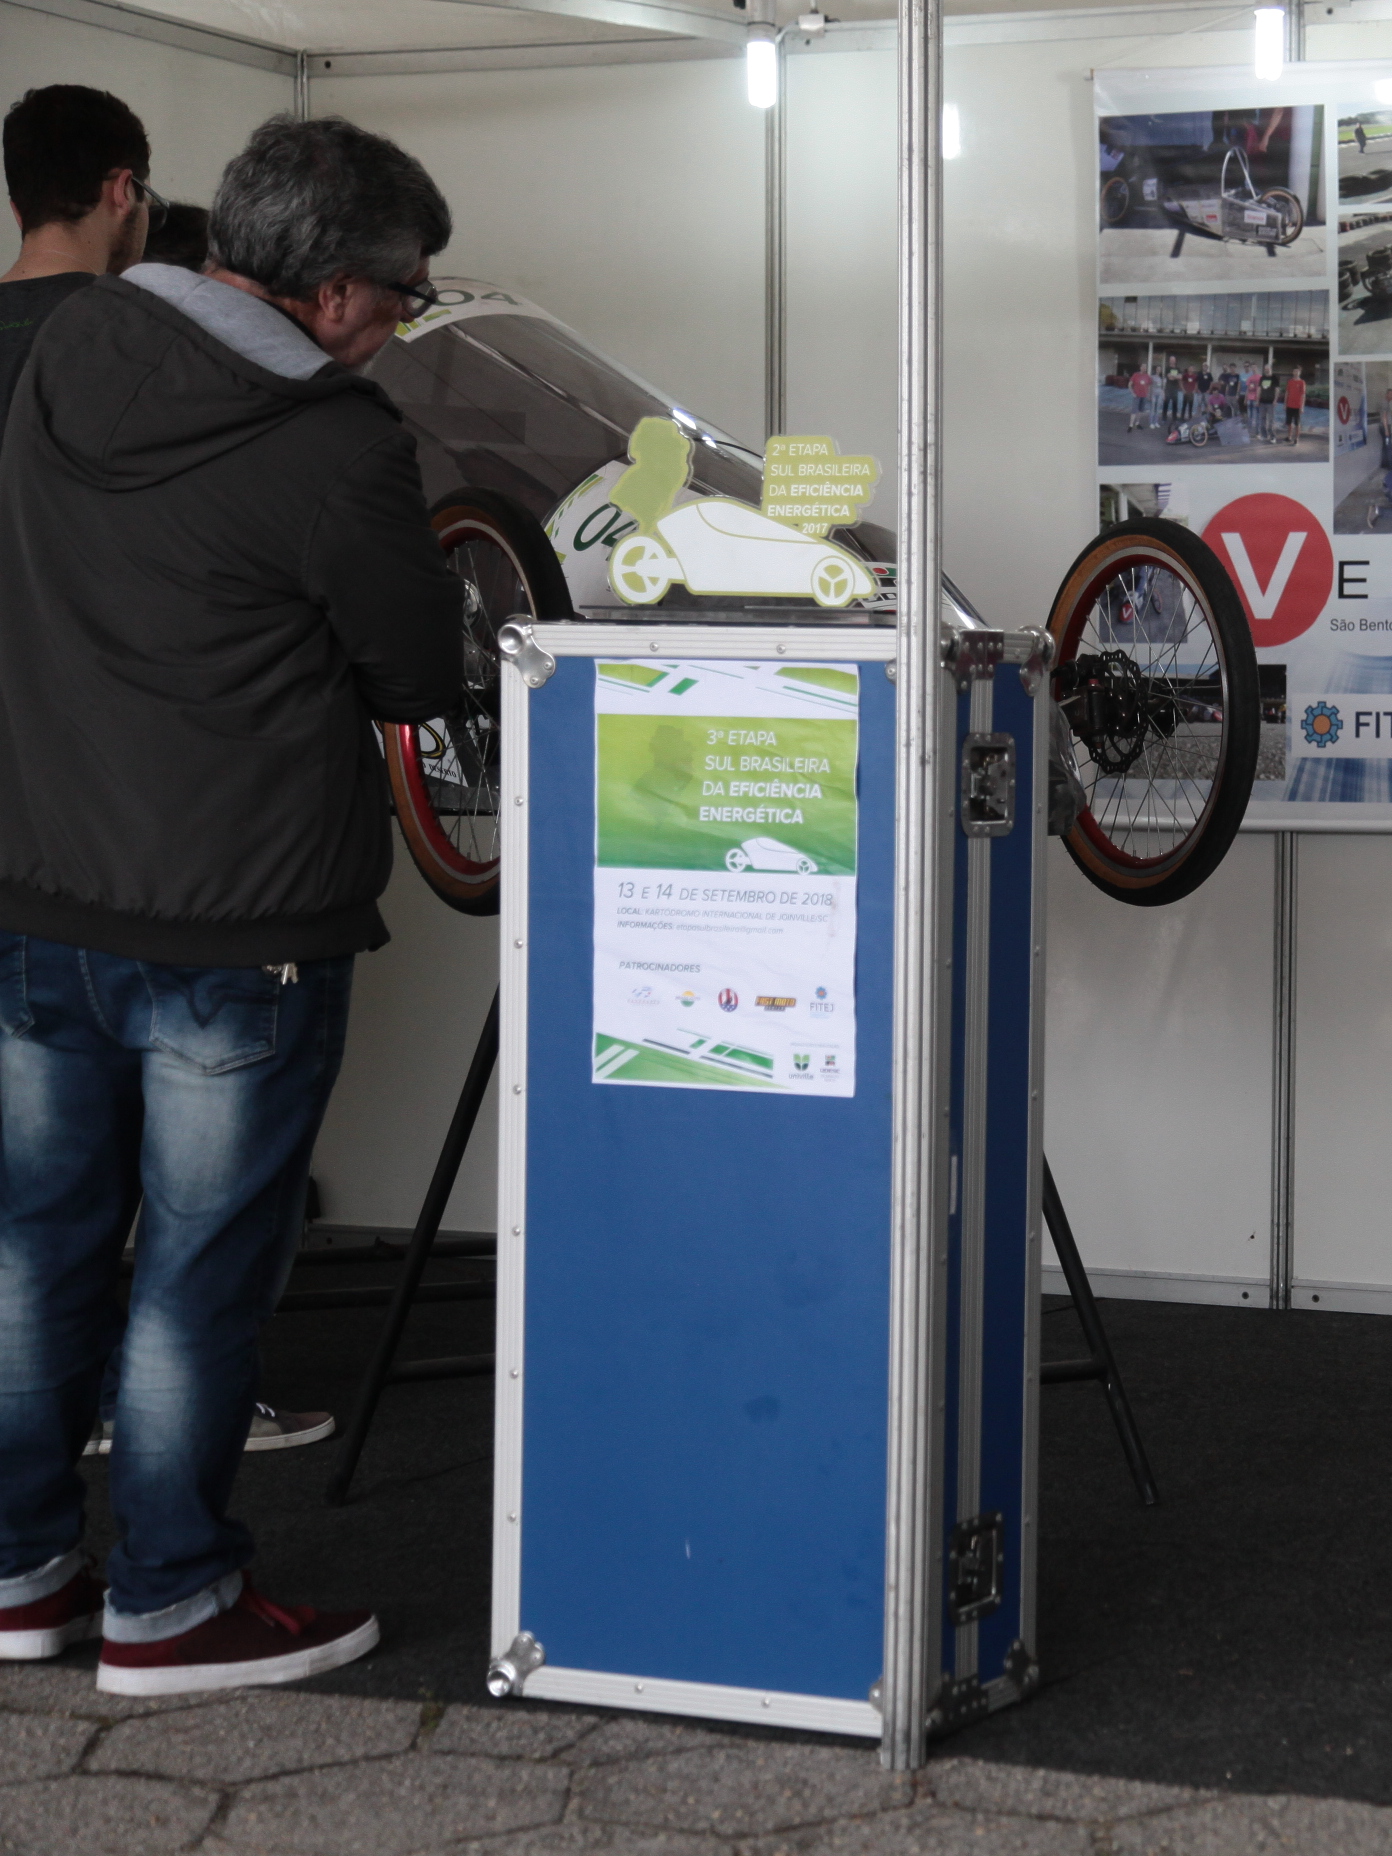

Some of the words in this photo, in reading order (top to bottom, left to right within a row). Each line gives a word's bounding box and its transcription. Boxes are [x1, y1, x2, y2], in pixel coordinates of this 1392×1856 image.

[772, 444, 785, 456] 2ª
[789, 444, 828, 456] ETAPA
[770, 464, 794, 476] SUL
[798, 464, 870, 476] BRASILEIRA
[769, 484, 787, 496] DA
[790, 482, 864, 496] EFICIÊNCIA
[767, 502, 850, 517] ENERGÉTICA
[802, 523, 828, 534] 2017
[1330, 617, 1355, 632] São
[706, 729, 724, 745] 3ª
[728, 730, 777, 746] ETAPA
[704, 755, 735, 771] SUL
[740, 756, 830, 773] BRASILEIRA
[702, 781, 725, 796] DA
[729, 778, 822, 799] EFICIÊNCIA
[699, 804, 804, 824] ENERGÉTICA
[617, 881, 635, 899] 13
[641, 886, 651, 899] E
[656, 883, 673, 900] 14
[679, 887, 698, 901] DE
[701, 889, 776, 904] SETEMBRO
[779, 891, 798, 905] DE
[801, 892, 833, 906] 2018
[702, 910, 763, 920] INTERNACIONAL
[765, 912, 776, 920] DE
[619, 961, 701, 974] PATROCINADORES
[810, 1002, 834, 1012] FITEJ
